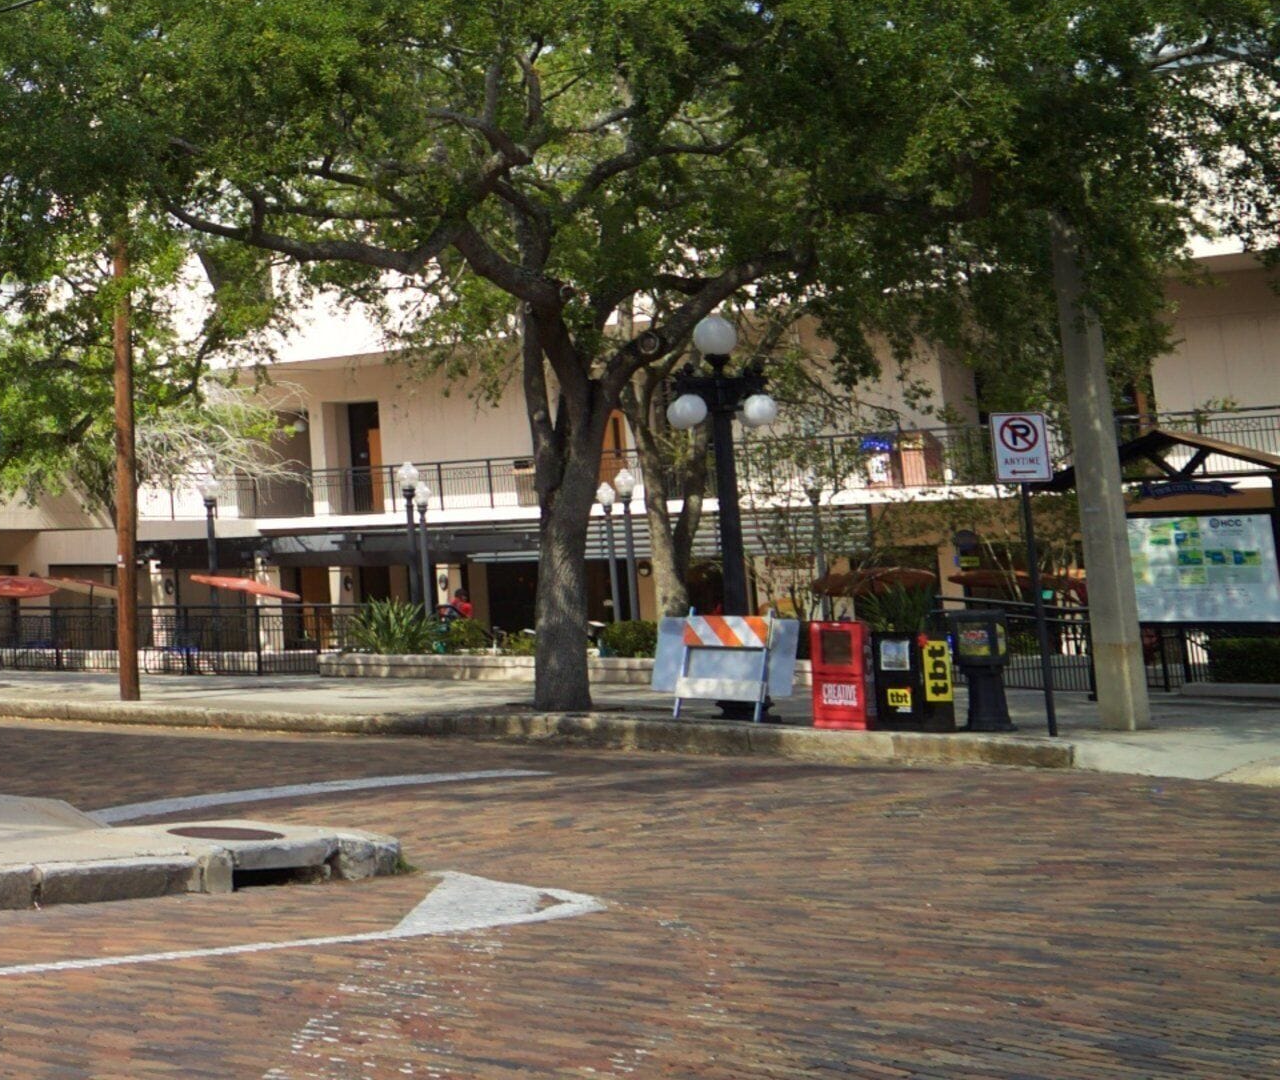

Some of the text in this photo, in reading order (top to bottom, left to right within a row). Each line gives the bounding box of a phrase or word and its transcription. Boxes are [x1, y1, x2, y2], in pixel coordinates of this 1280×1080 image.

[1004, 455, 1041, 466] ANYTIME
[928, 646, 949, 696] tbt
[822, 683, 856, 700] CREATIVE
[890, 691, 909, 704] tbt
